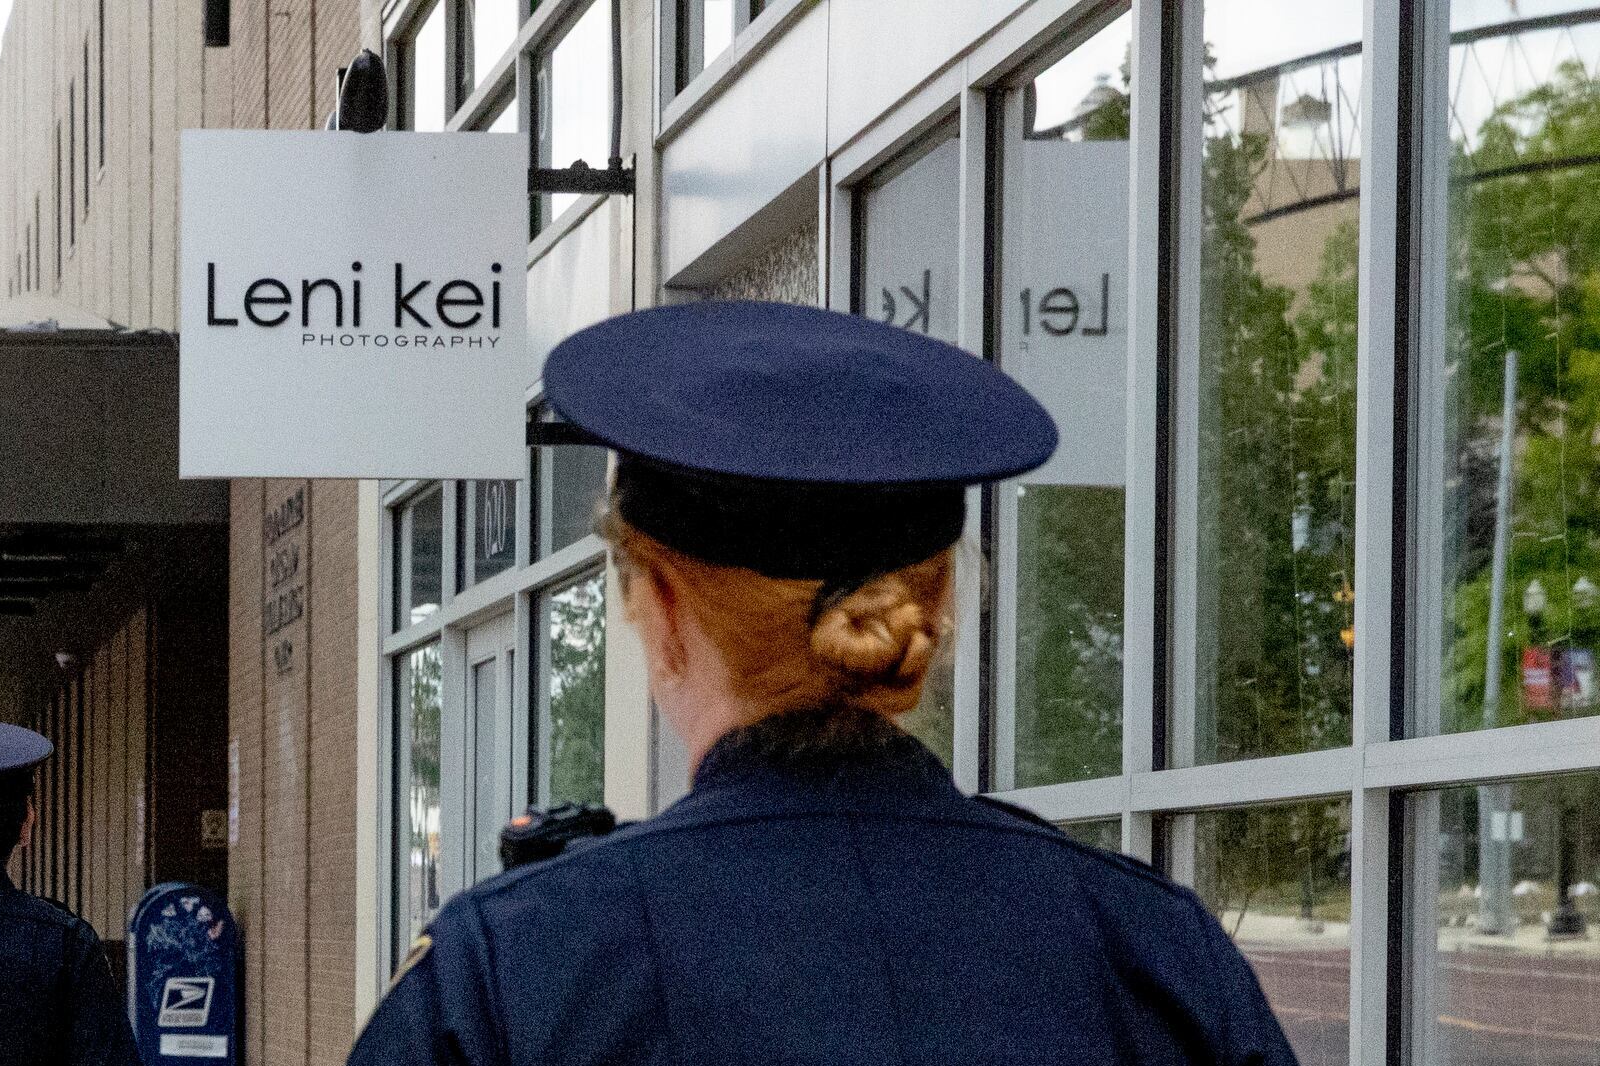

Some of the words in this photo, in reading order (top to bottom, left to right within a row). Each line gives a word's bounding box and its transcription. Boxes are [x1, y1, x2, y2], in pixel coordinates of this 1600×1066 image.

[207, 261, 362, 328] Leni
[394, 262, 502, 329] kei
[302, 333, 500, 348] PHOTOGRAPHY
[484, 480, 506, 559] 620
